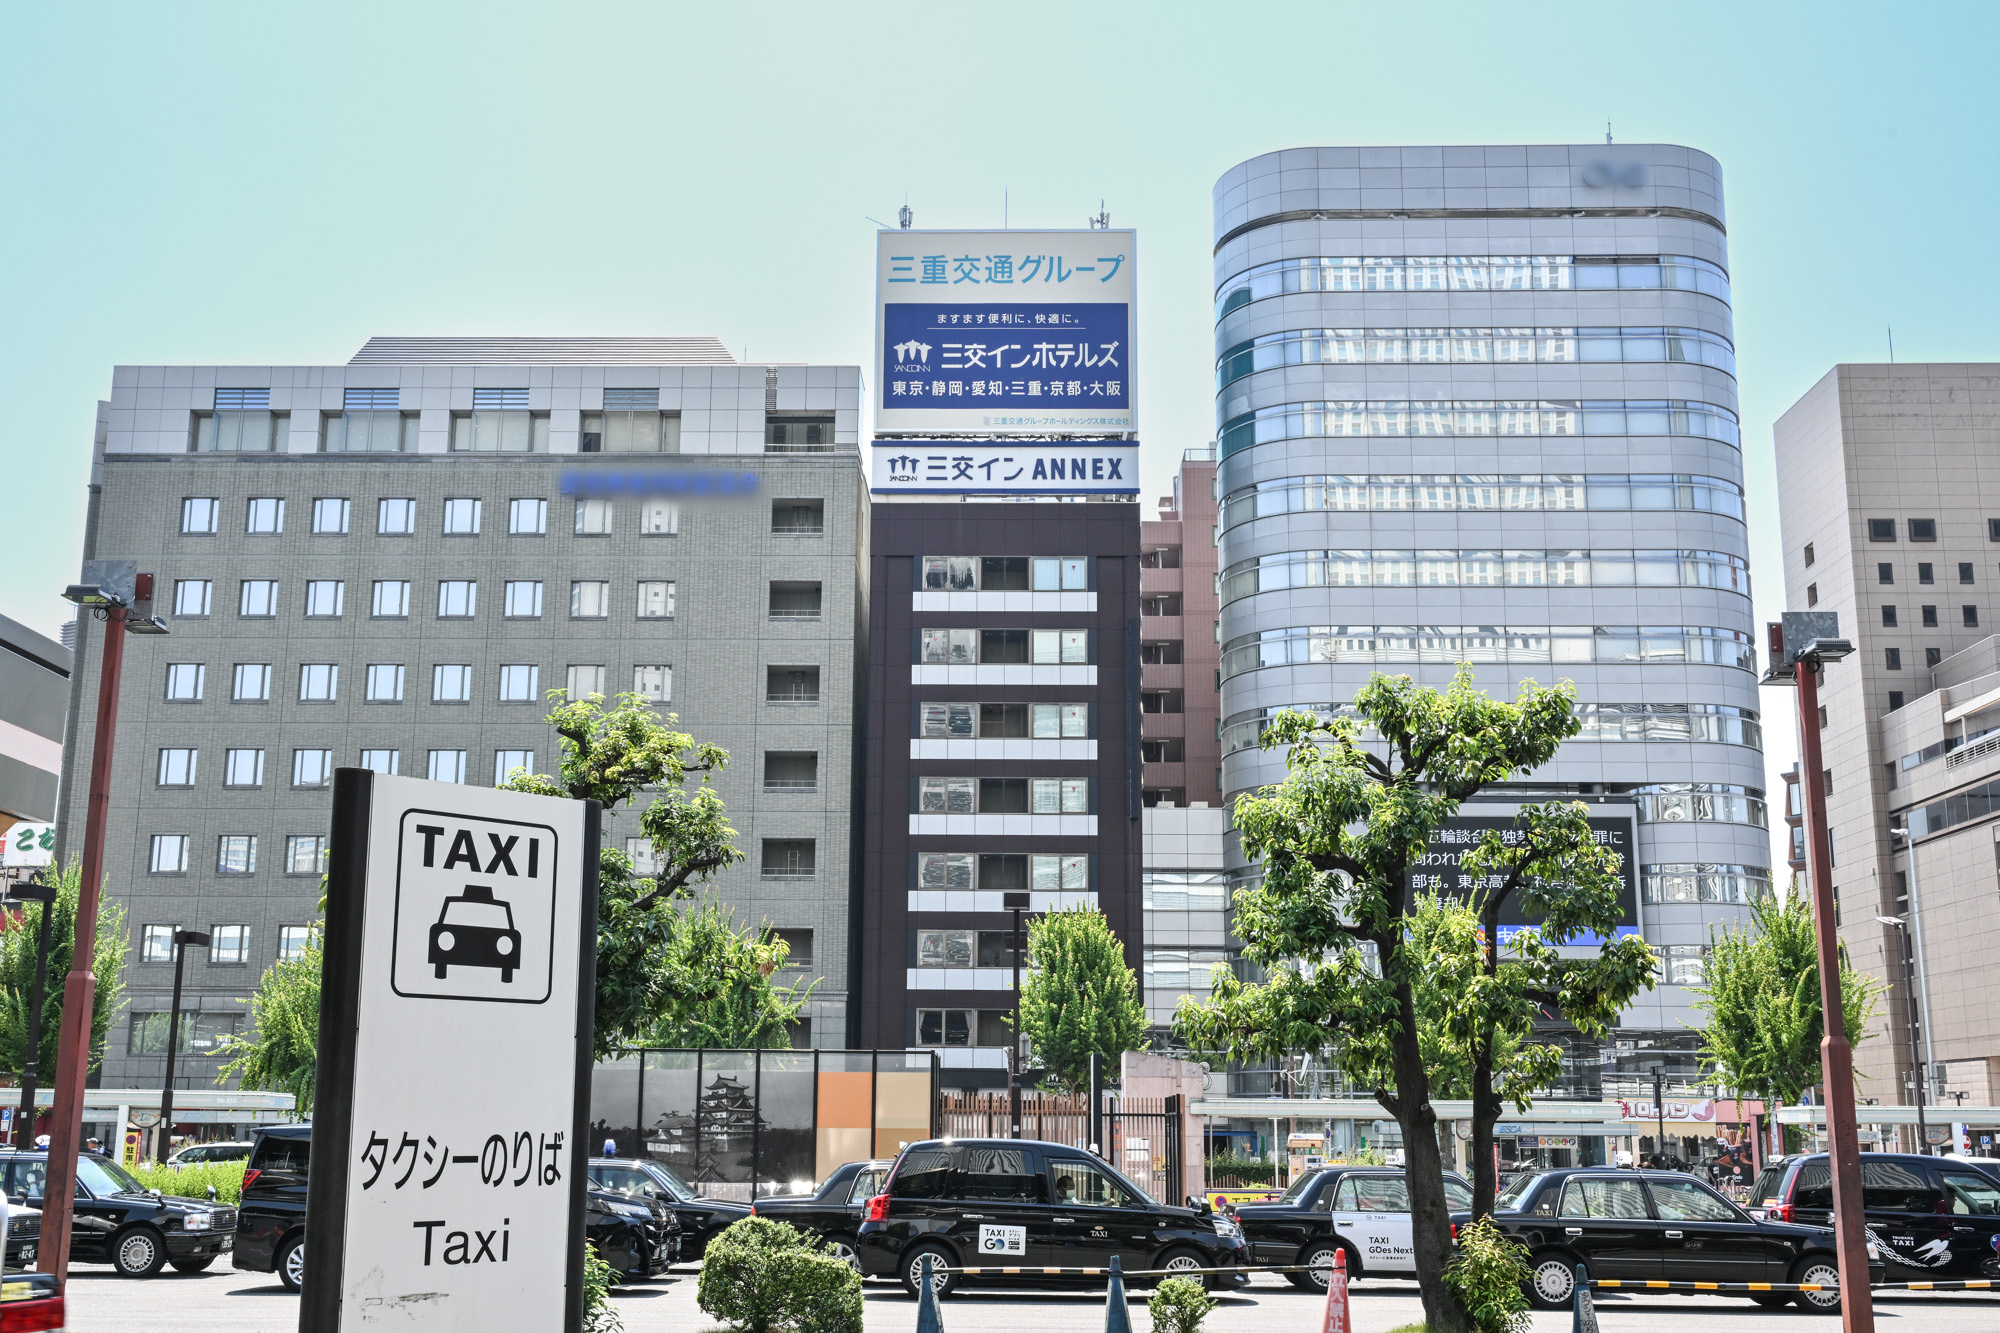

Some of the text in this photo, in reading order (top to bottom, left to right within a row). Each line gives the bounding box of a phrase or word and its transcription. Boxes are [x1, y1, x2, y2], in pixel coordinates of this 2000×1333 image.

[887, 254, 1126, 284] 三重交通グループ
[936, 313, 1081, 324] ますます便利に、快適に。
[941, 340, 1119, 369] 三交インホテルズ
[892, 380, 1121, 396] 東京・静岡・愛知・三重・京都・大阪
[992, 416, 1130, 426] 三重交通グループホールディングス株式会社
[926, 456, 1123, 481] 三交イン ANNEX
[416, 824, 540, 879] TAXI
[1499, 1125, 1522, 1134] ESCA
[361, 1130, 565, 1191] タクシーのりば
[985, 1228, 1006, 1237] TAXI
[1090, 1230, 1108, 1238] TAXI
[1368, 1236, 1389, 1244] TAXI
[413, 1217, 510, 1266] Taxi
[984, 1238, 1005, 1251] GO
[1328, 1272, 1346, 1333] 立入禁止
